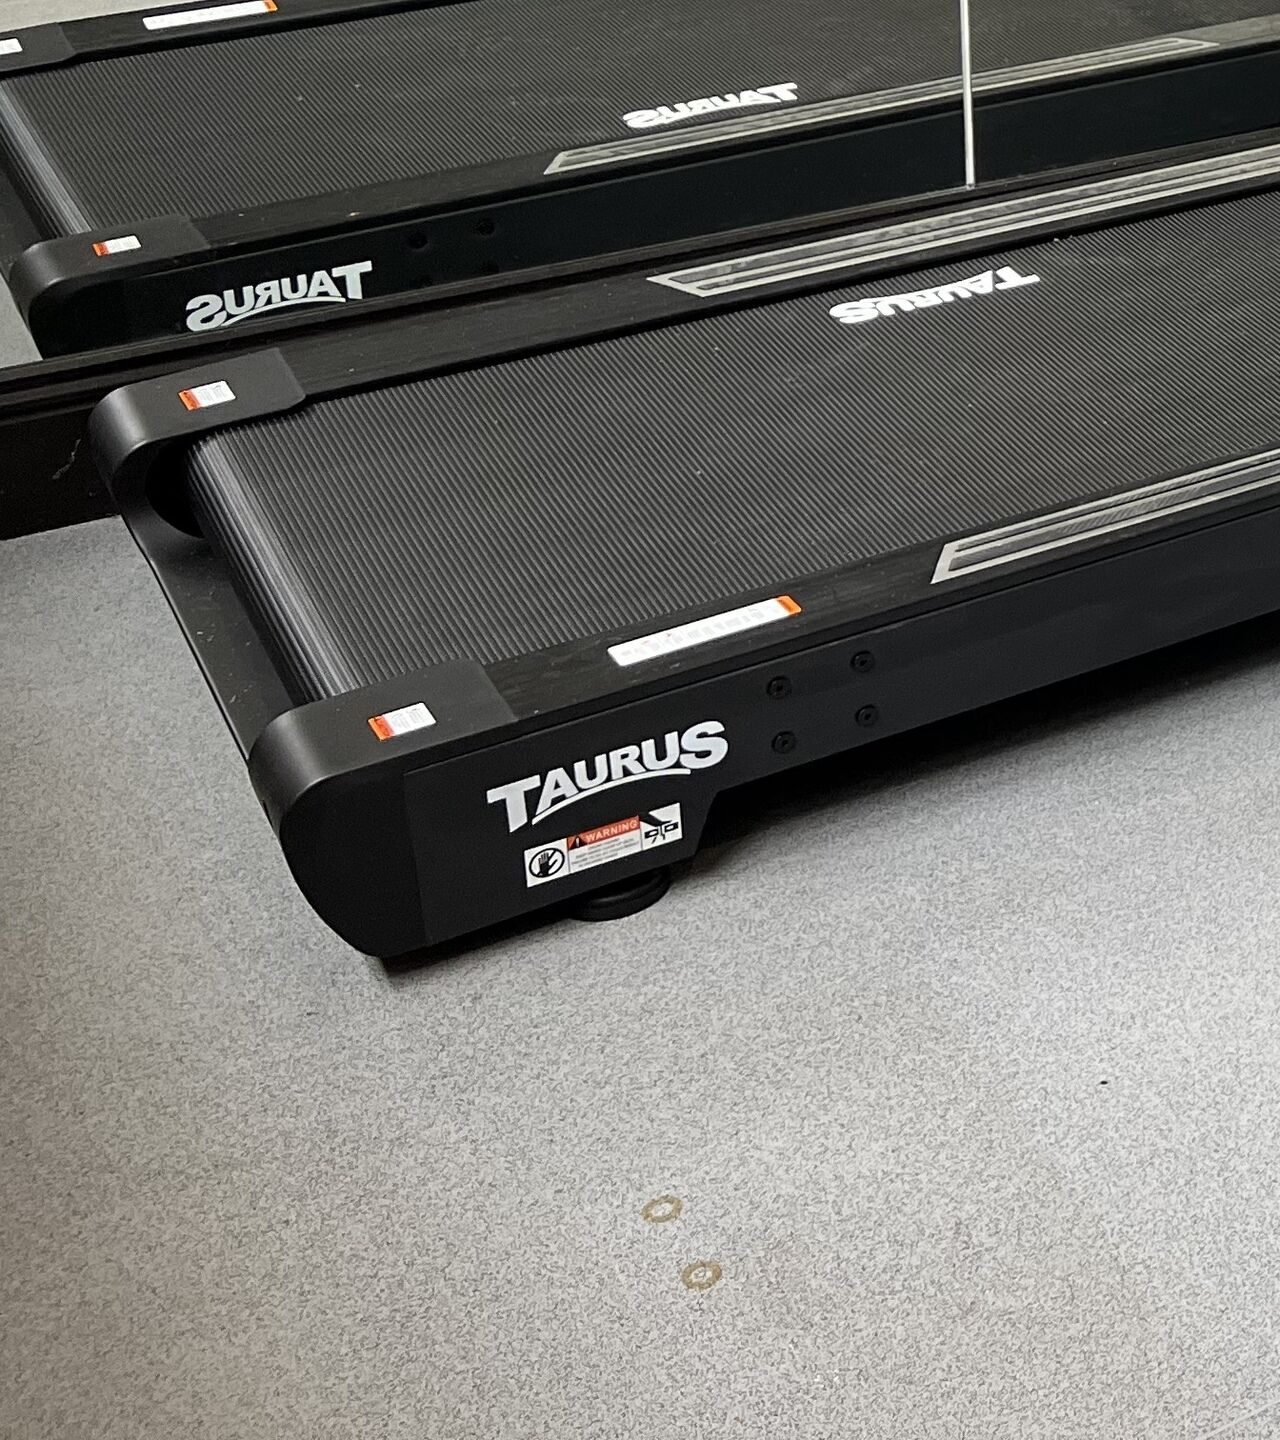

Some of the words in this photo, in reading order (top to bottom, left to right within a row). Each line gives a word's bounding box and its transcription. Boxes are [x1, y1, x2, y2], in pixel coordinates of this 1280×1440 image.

[829, 265, 1041, 324] TAURUS
[486, 720, 729, 833] TAURUS
[585, 819, 638, 842] WARNING
